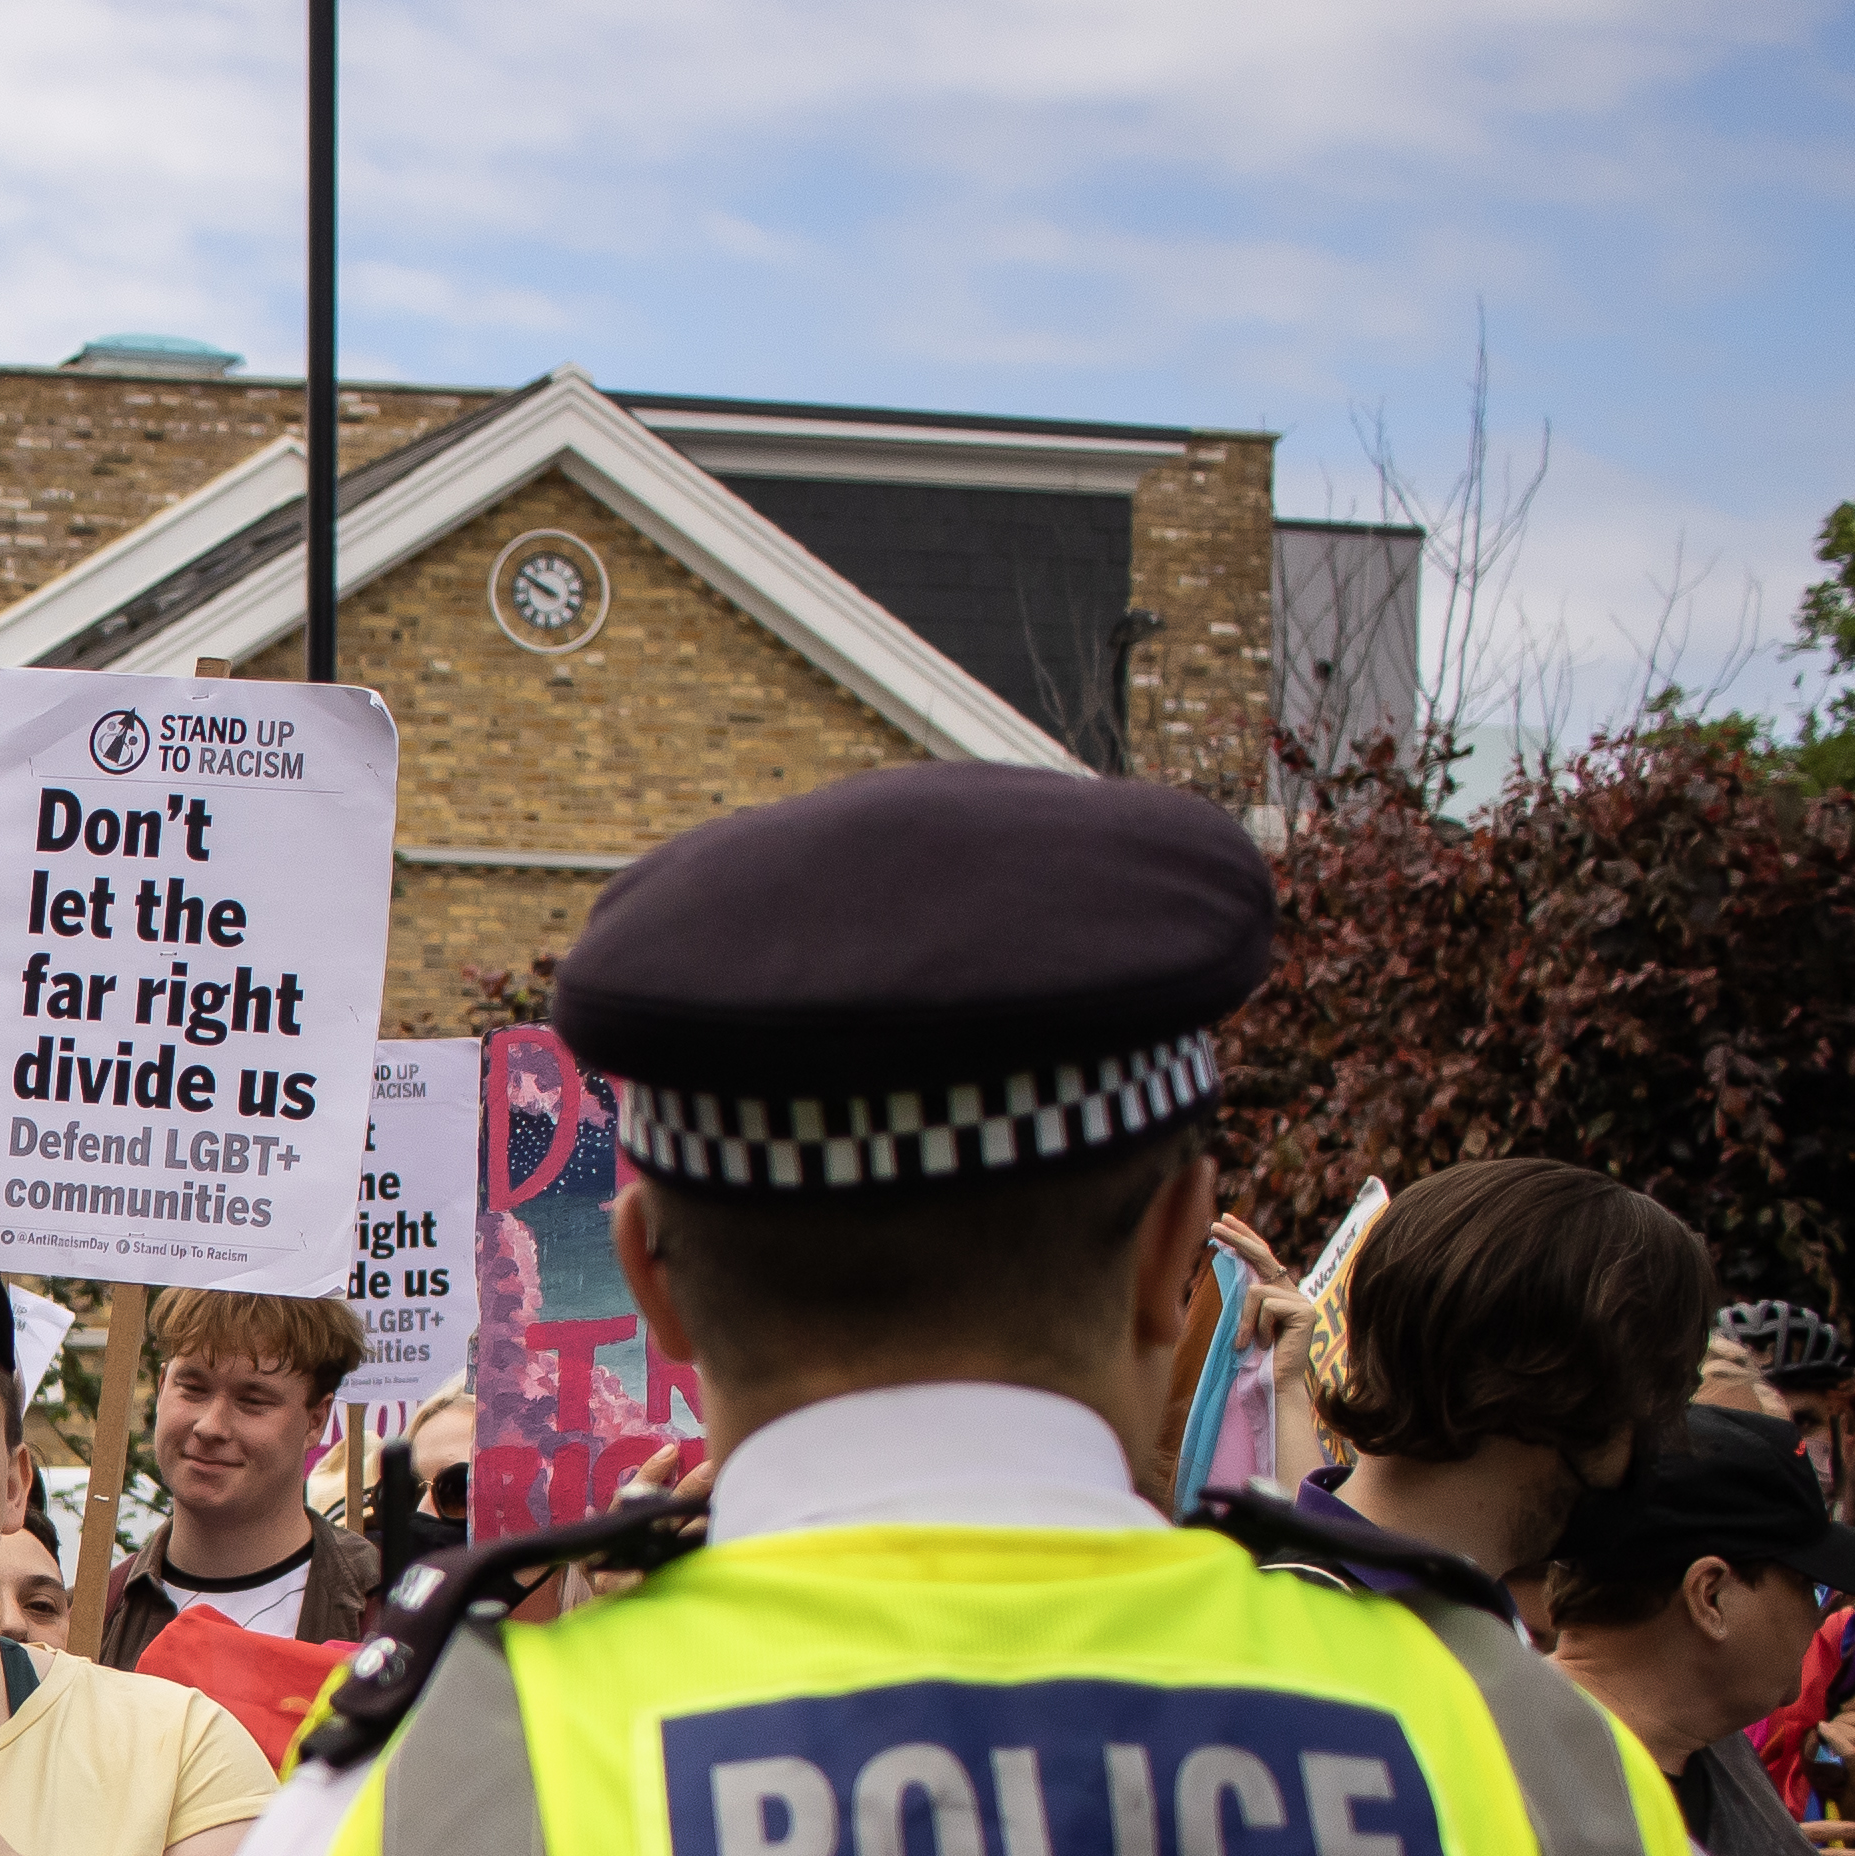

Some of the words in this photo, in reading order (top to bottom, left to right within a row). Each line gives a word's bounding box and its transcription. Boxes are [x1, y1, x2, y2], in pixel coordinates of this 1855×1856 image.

[160, 714, 248, 745] STAND
[256, 719, 295, 748] UP
[158, 745, 191, 773] TO
[198, 747, 304, 781] RACISM
[35, 787, 213, 862] Don't
[28, 869, 116, 940] let
[135, 877, 247, 949] the
[22, 952, 118, 1022] far
[135, 961, 304, 1047] right
[13, 1035, 217, 1114] divide
[238, 1068, 318, 1121] us
[373, 1082, 427, 1100] ACISM
[396, 1064, 419, 1080] UP
[9, 1116, 153, 1168] Defend
[164, 1127, 301, 1177] LGBT+
[4, 1177, 274, 1229] communities
[17, 1231, 110, 1254] @AntiRacismDay
[132, 1241, 168, 1257] Stand
[170, 1243, 187, 1259] Up
[190, 1245, 204, 1259] To
[206, 1247, 248, 1263] Racism
[355, 1210, 437, 1260] ight
[1308, 1222, 1358, 1298] Worker
[404, 1268, 449, 1298] us
[365, 1306, 445, 1334] LGBT+
